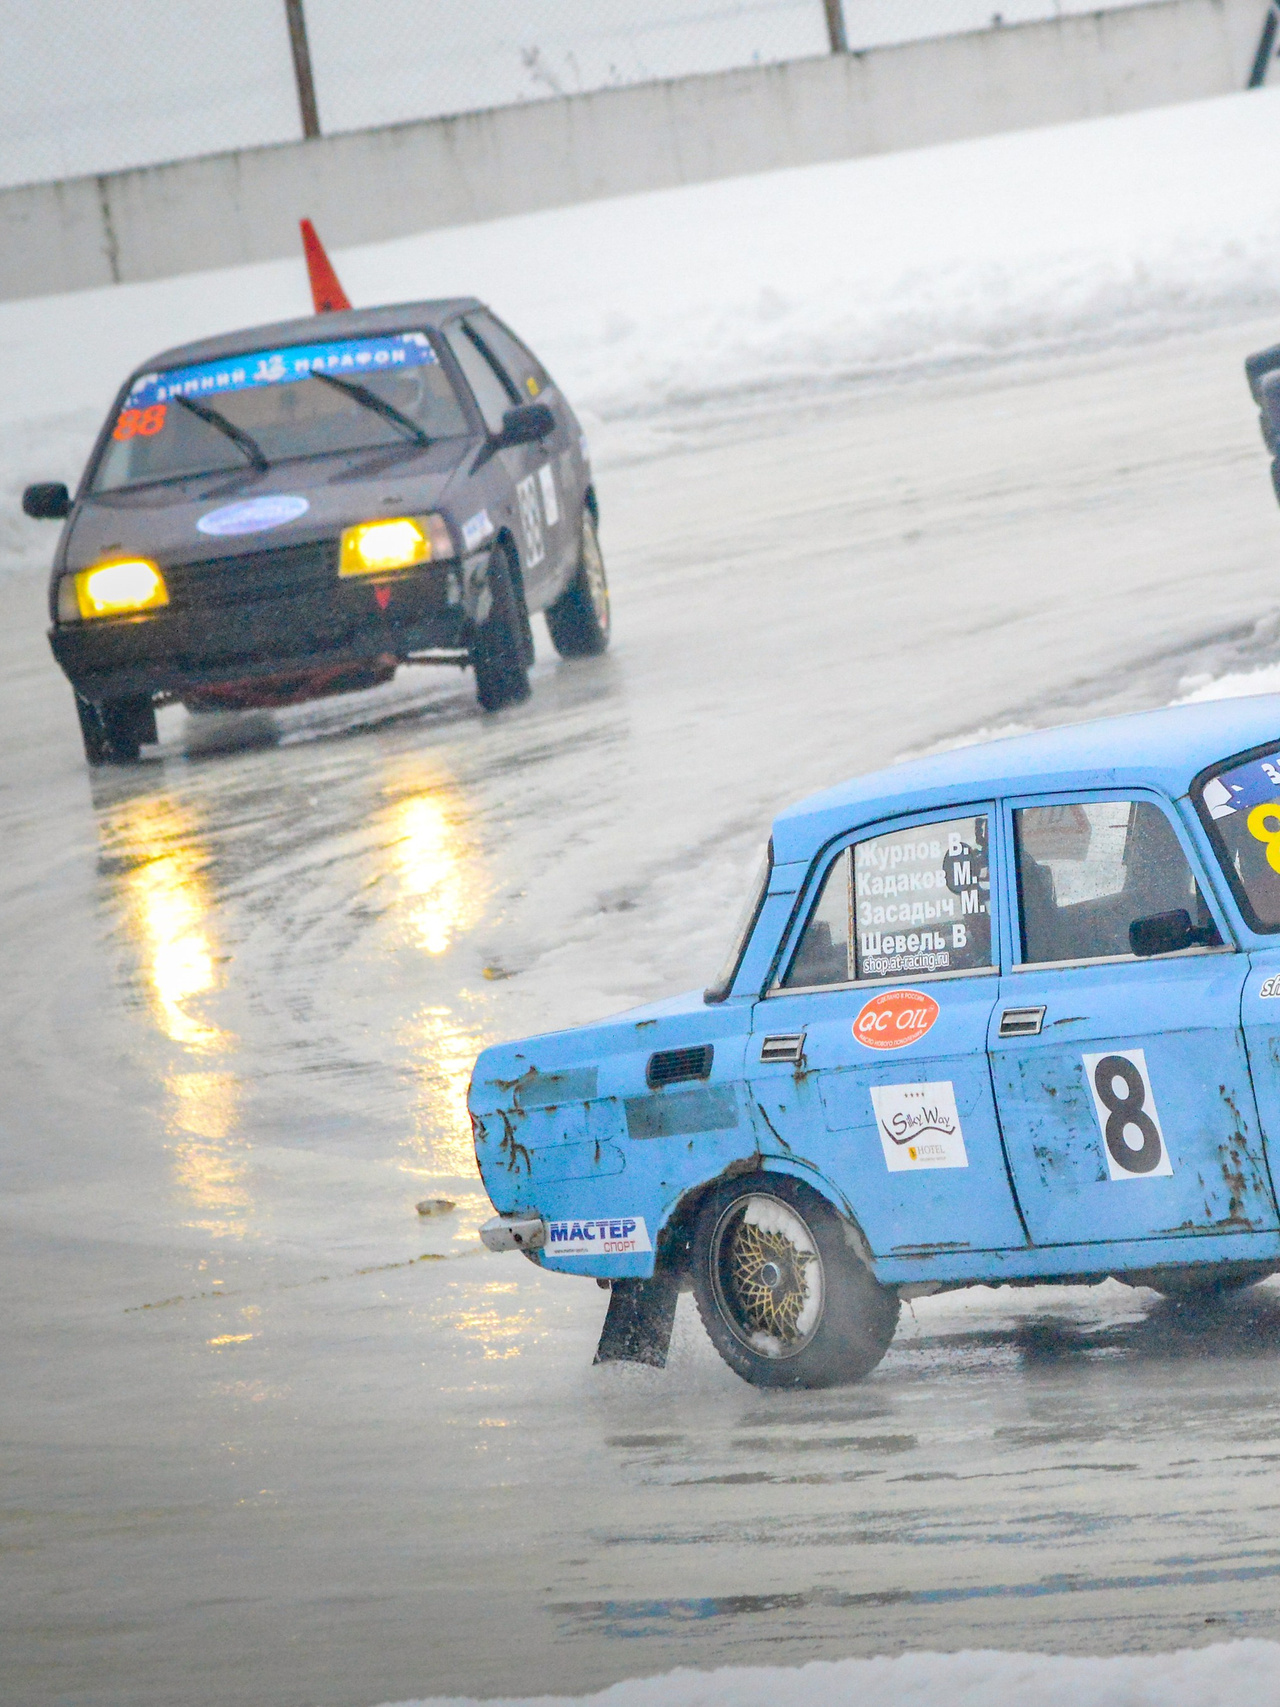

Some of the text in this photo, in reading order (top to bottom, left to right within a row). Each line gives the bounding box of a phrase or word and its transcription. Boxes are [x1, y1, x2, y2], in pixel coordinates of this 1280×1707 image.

[156, 367, 247, 402] ЗИМНИЙ
[295, 348, 407, 372] МАРАФОН
[113, 404, 167, 441] 88
[857, 832, 969, 872] Журлов В.
[857, 861, 978, 897] Кадаков М.
[859, 890, 986, 926] Засадыч М.
[861, 931, 946, 957] Шевель
[863, 951, 950, 976] shop.at-racing.ru
[859, 1009, 927, 1032] QC OIL
[1094, 1055, 1162, 1173] 8
[917, 1145, 946, 1155] HOTEL
[550, 1219, 636, 1242] МАСТЕР
[603, 1240, 635, 1253] СПОРТ
